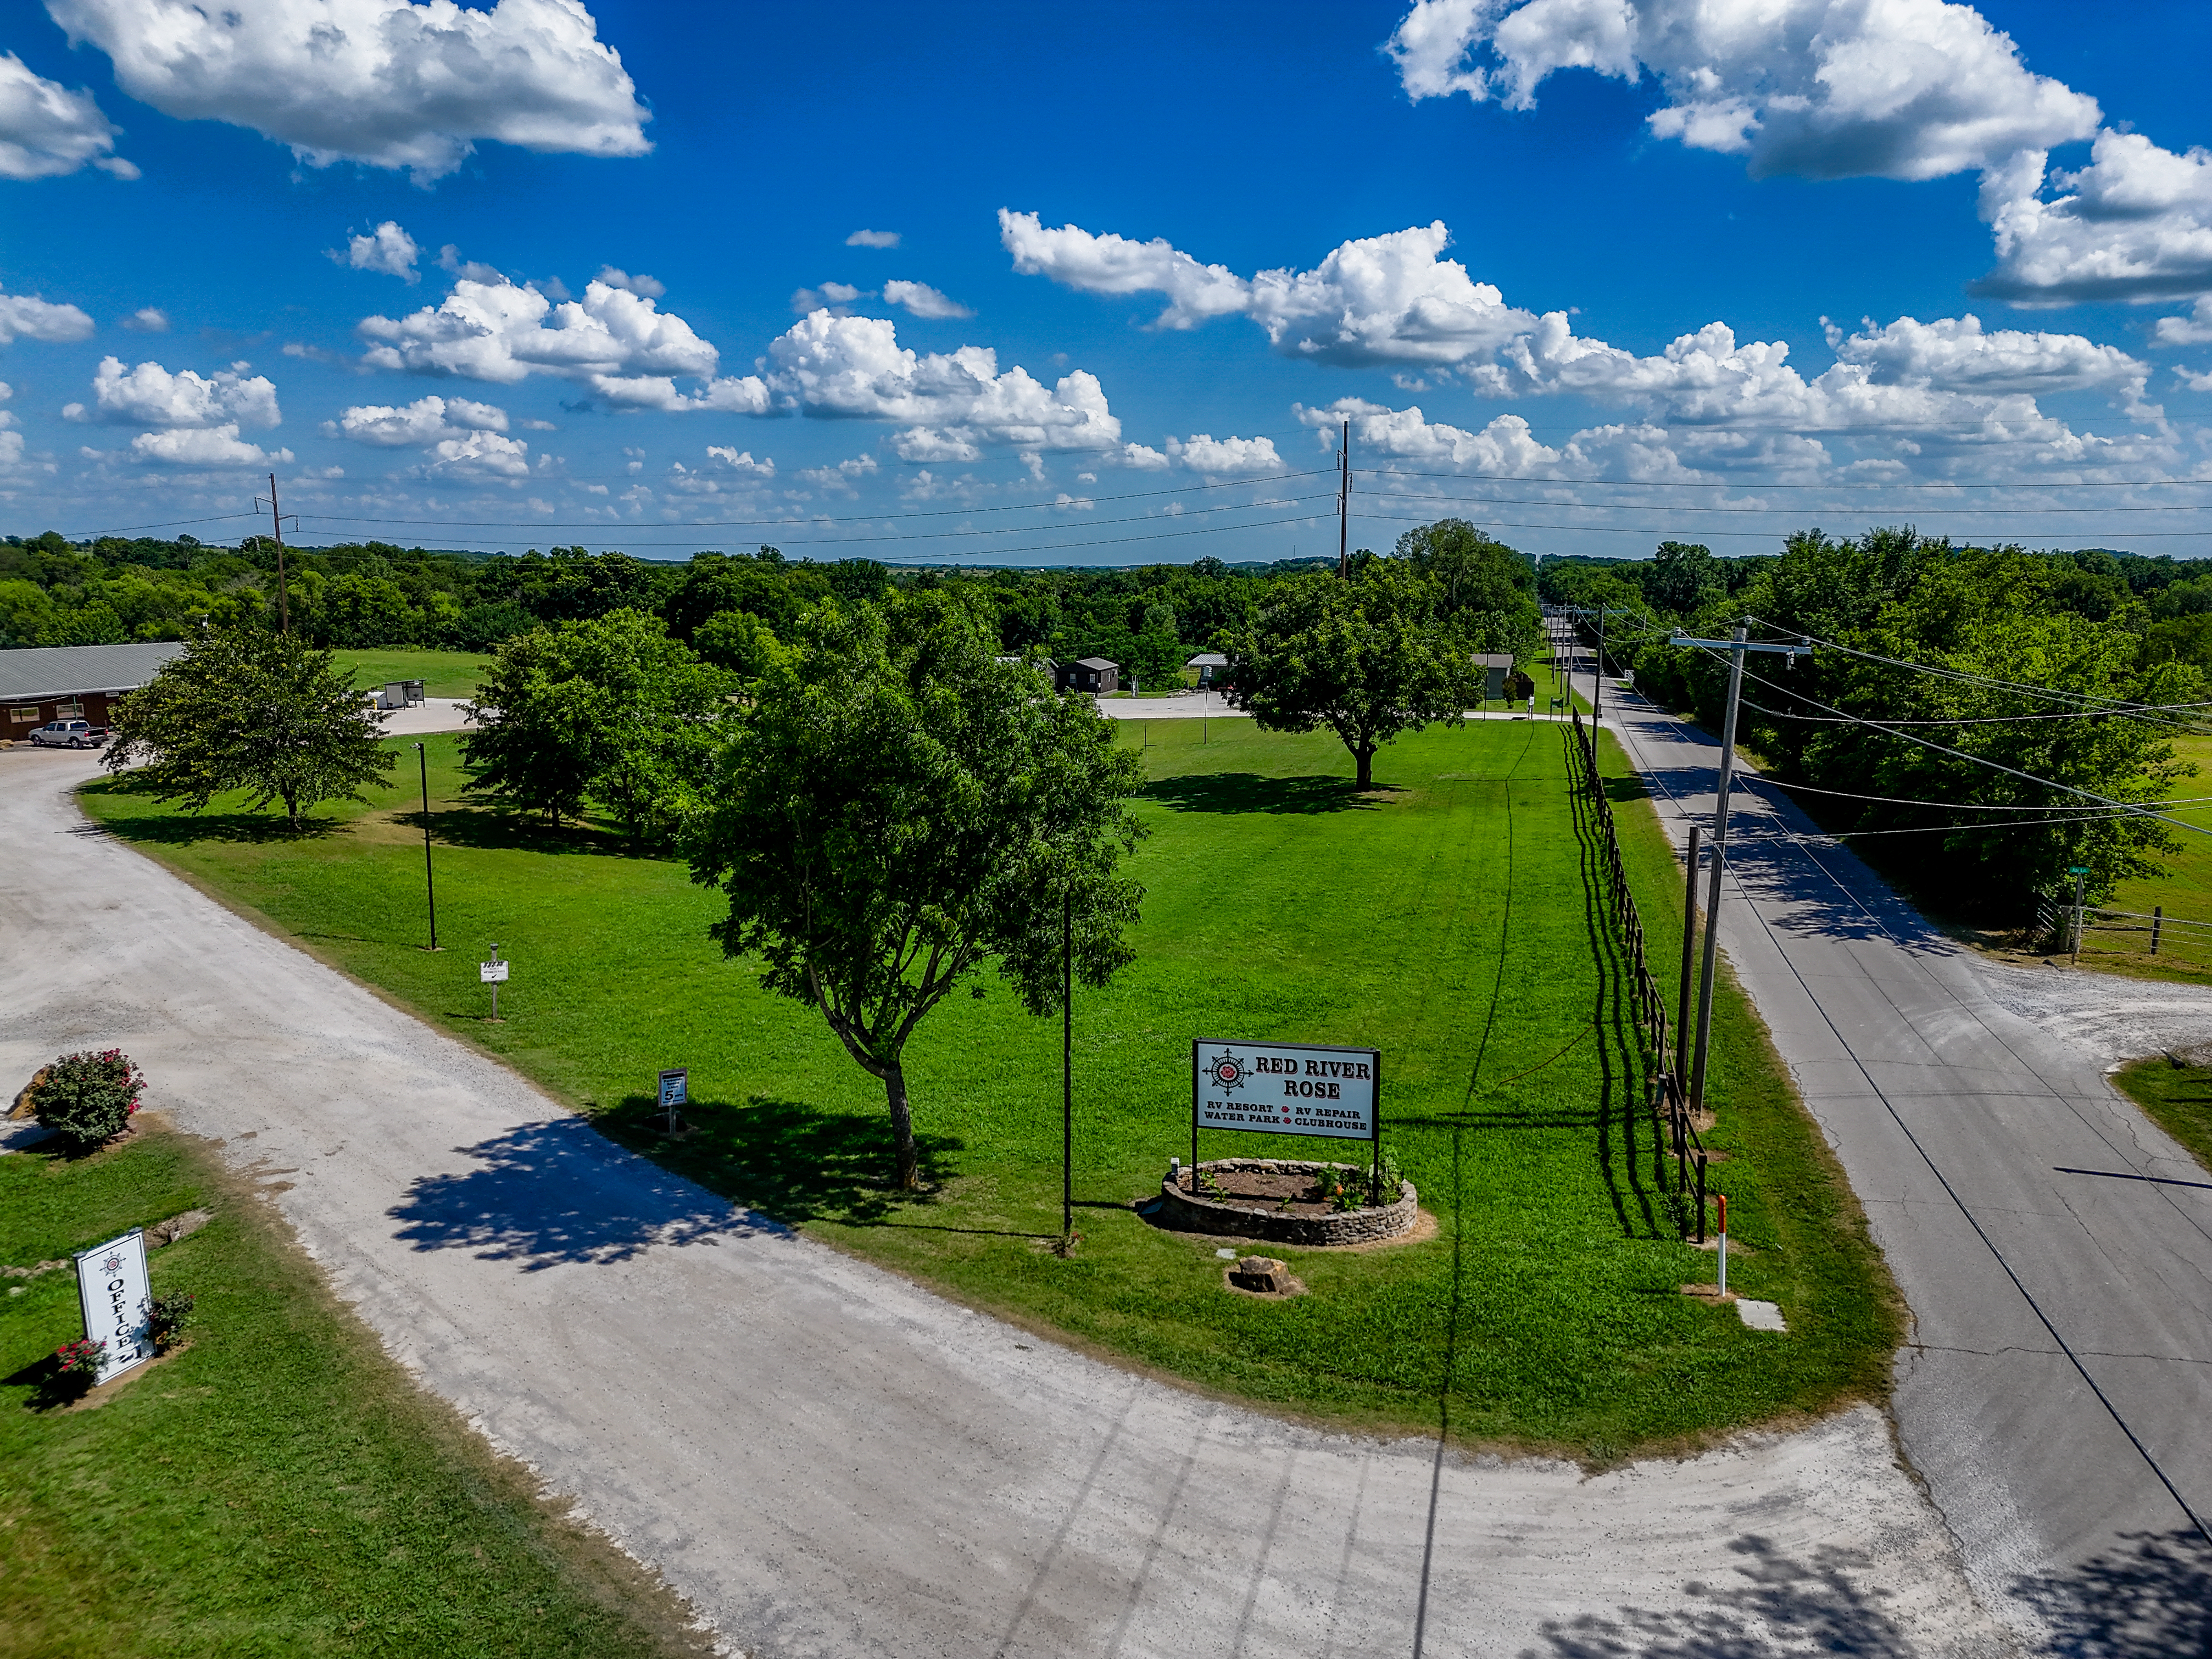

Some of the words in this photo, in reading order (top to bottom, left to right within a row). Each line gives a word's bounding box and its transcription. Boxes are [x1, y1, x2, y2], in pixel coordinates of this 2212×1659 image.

[1256, 1056, 1298, 1075] RED
[1305, 1060, 1370, 1079] RIVER
[665, 1090, 673, 1100] 5
[1284, 1079, 1340, 1099] ROSE
[1207, 1101, 1223, 1109] RV
[1226, 1102, 1274, 1113] RESORT
[1295, 1107, 1312, 1115] RV
[1316, 1108, 1361, 1120] REPAIR
[1204, 1111, 1245, 1122] WATER
[1249, 1114, 1280, 1124] PARK
[1294, 1117, 1367, 1131] CLUBHOUSE
[107, 1279, 132, 1350] OFFICE
